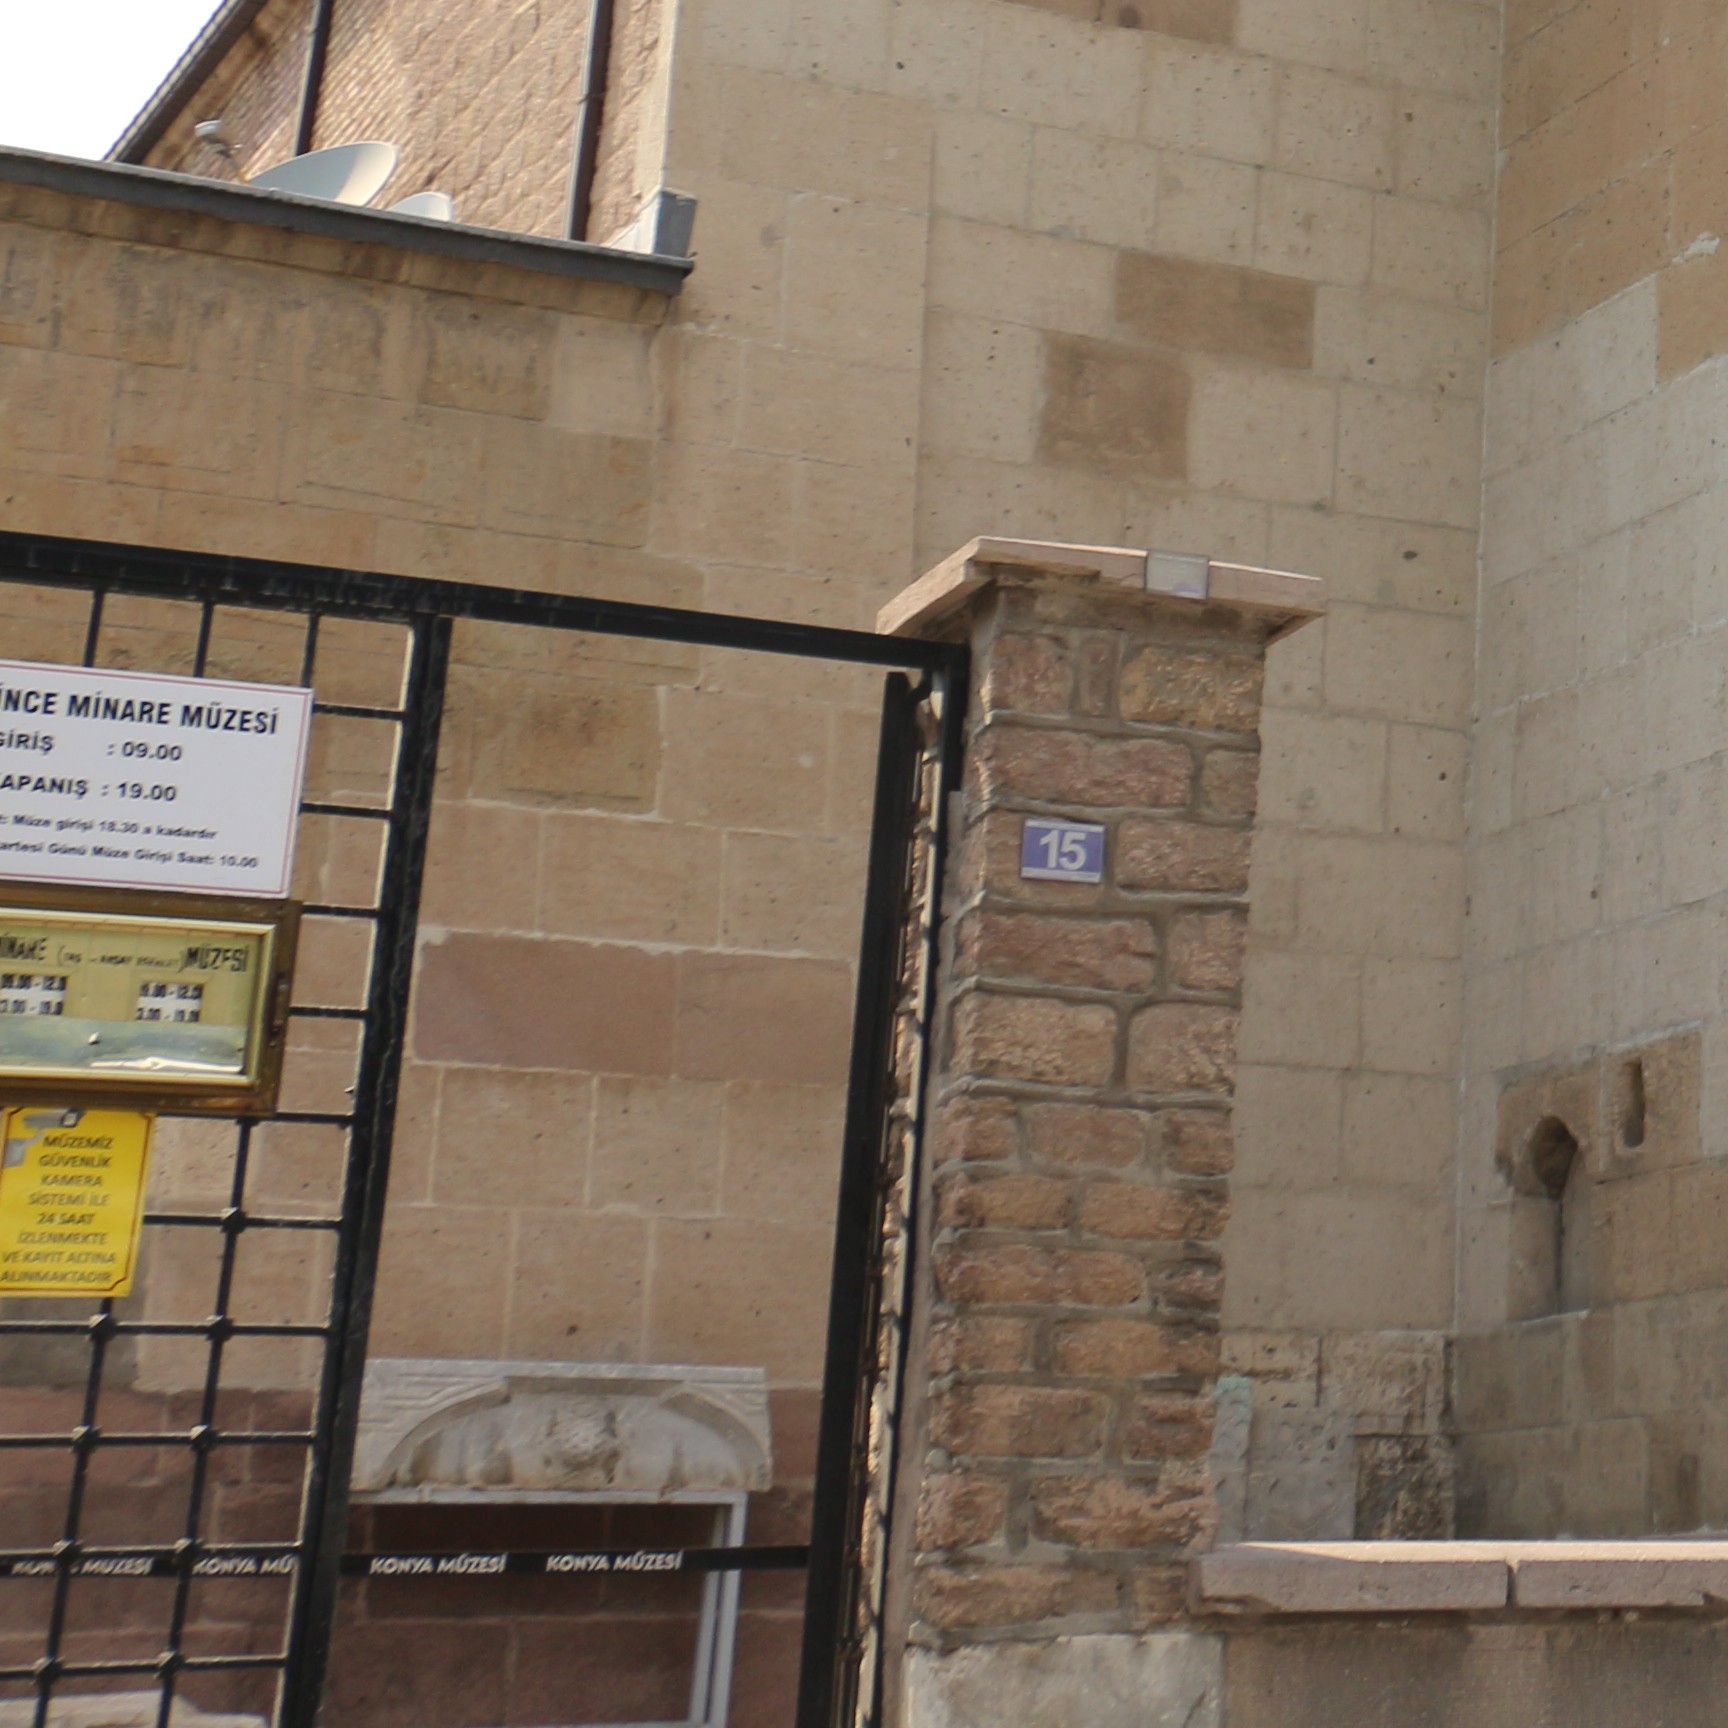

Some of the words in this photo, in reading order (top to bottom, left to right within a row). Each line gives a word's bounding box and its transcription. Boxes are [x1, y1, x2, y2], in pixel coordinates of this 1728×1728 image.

[67, 691, 171, 725] MİNARE
[180, 701, 279, 734] MÜZESİ
[122, 741, 182, 761] 09.00
[118, 782, 176, 801] 19.00
[1040, 830, 1087, 871] 15
[42, 1133, 113, 1149] MÜZEMİZ
[39, 1152, 111, 1168] GÜVENLİK
[41, 1174, 102, 1186] KAMERA
[37, 1212, 55, 1225] 24
[58, 1212, 95, 1225] SAAT
[191, 1556, 257, 1575] KONYA
[369, 1557, 434, 1575] KONYA
[436, 1551, 509, 1575] MÜZESİ
[546, 1553, 609, 1572] KONYA
[612, 1548, 684, 1571] MÜZESİ
